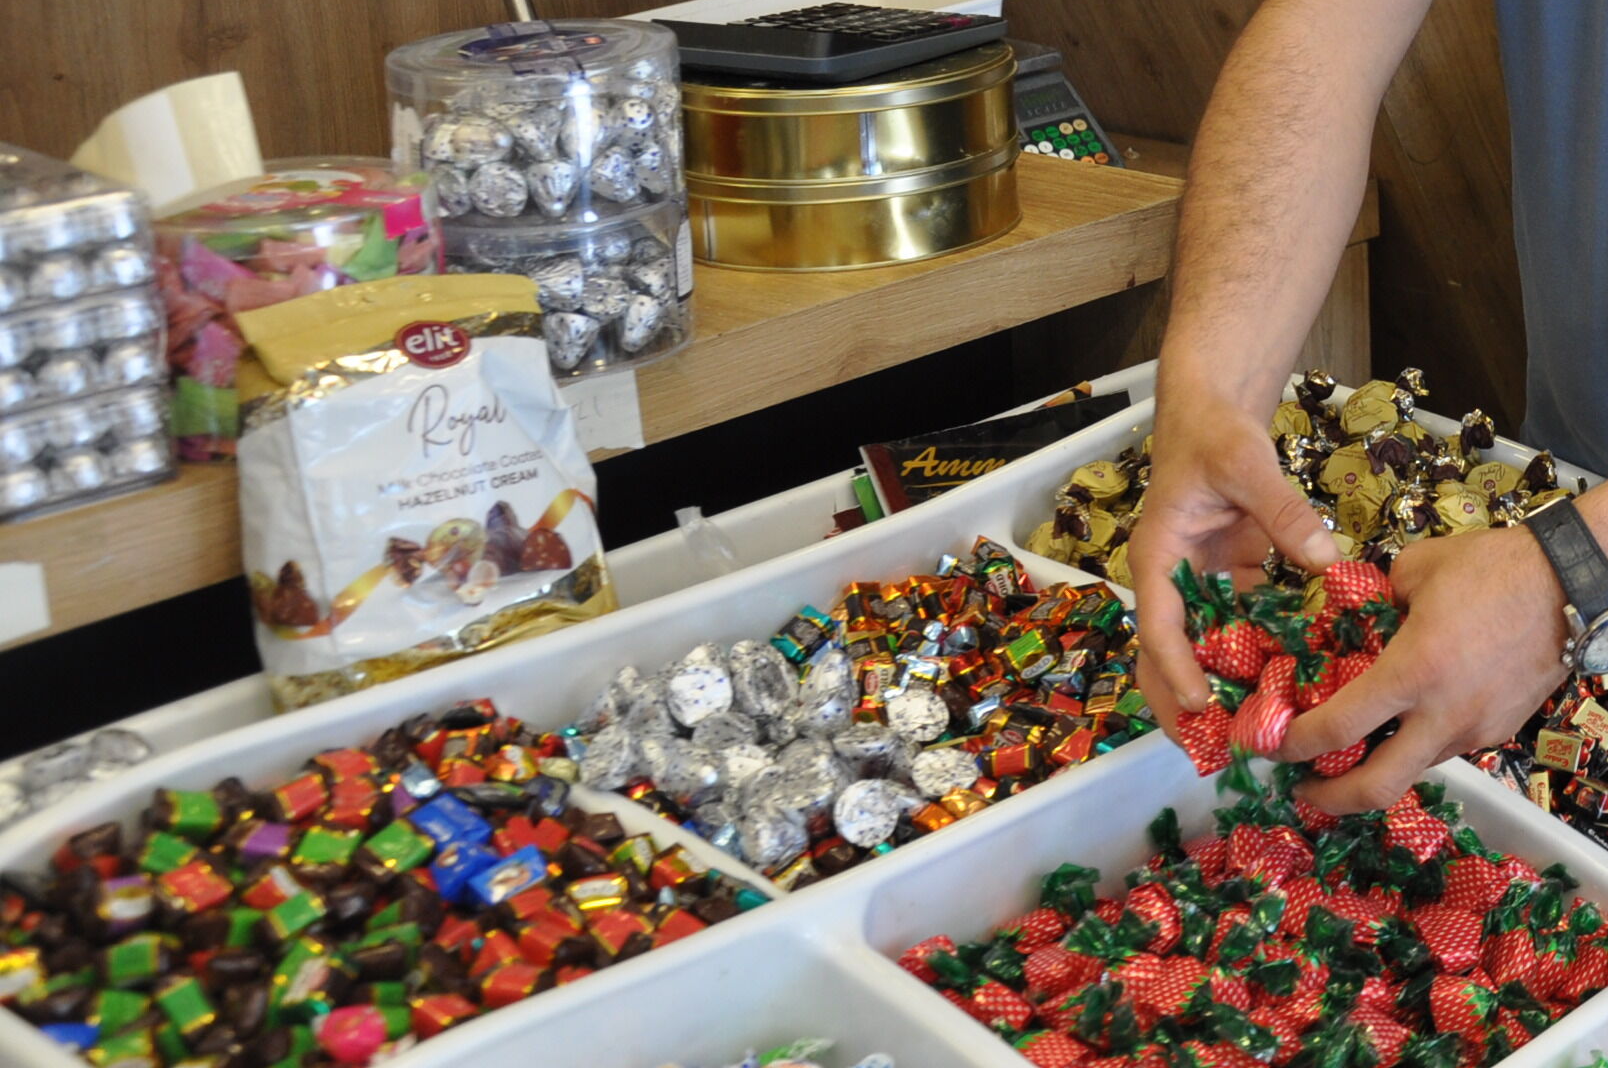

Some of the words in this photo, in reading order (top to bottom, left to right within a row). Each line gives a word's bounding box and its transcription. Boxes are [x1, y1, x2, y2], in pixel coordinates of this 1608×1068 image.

[405, 326, 460, 355] elit
[407, 384, 508, 458] Royal
[399, 481, 486, 510] HAZELNUT
[490, 468, 539, 490] CREAM
[416, 461, 497, 488] Chocolate
